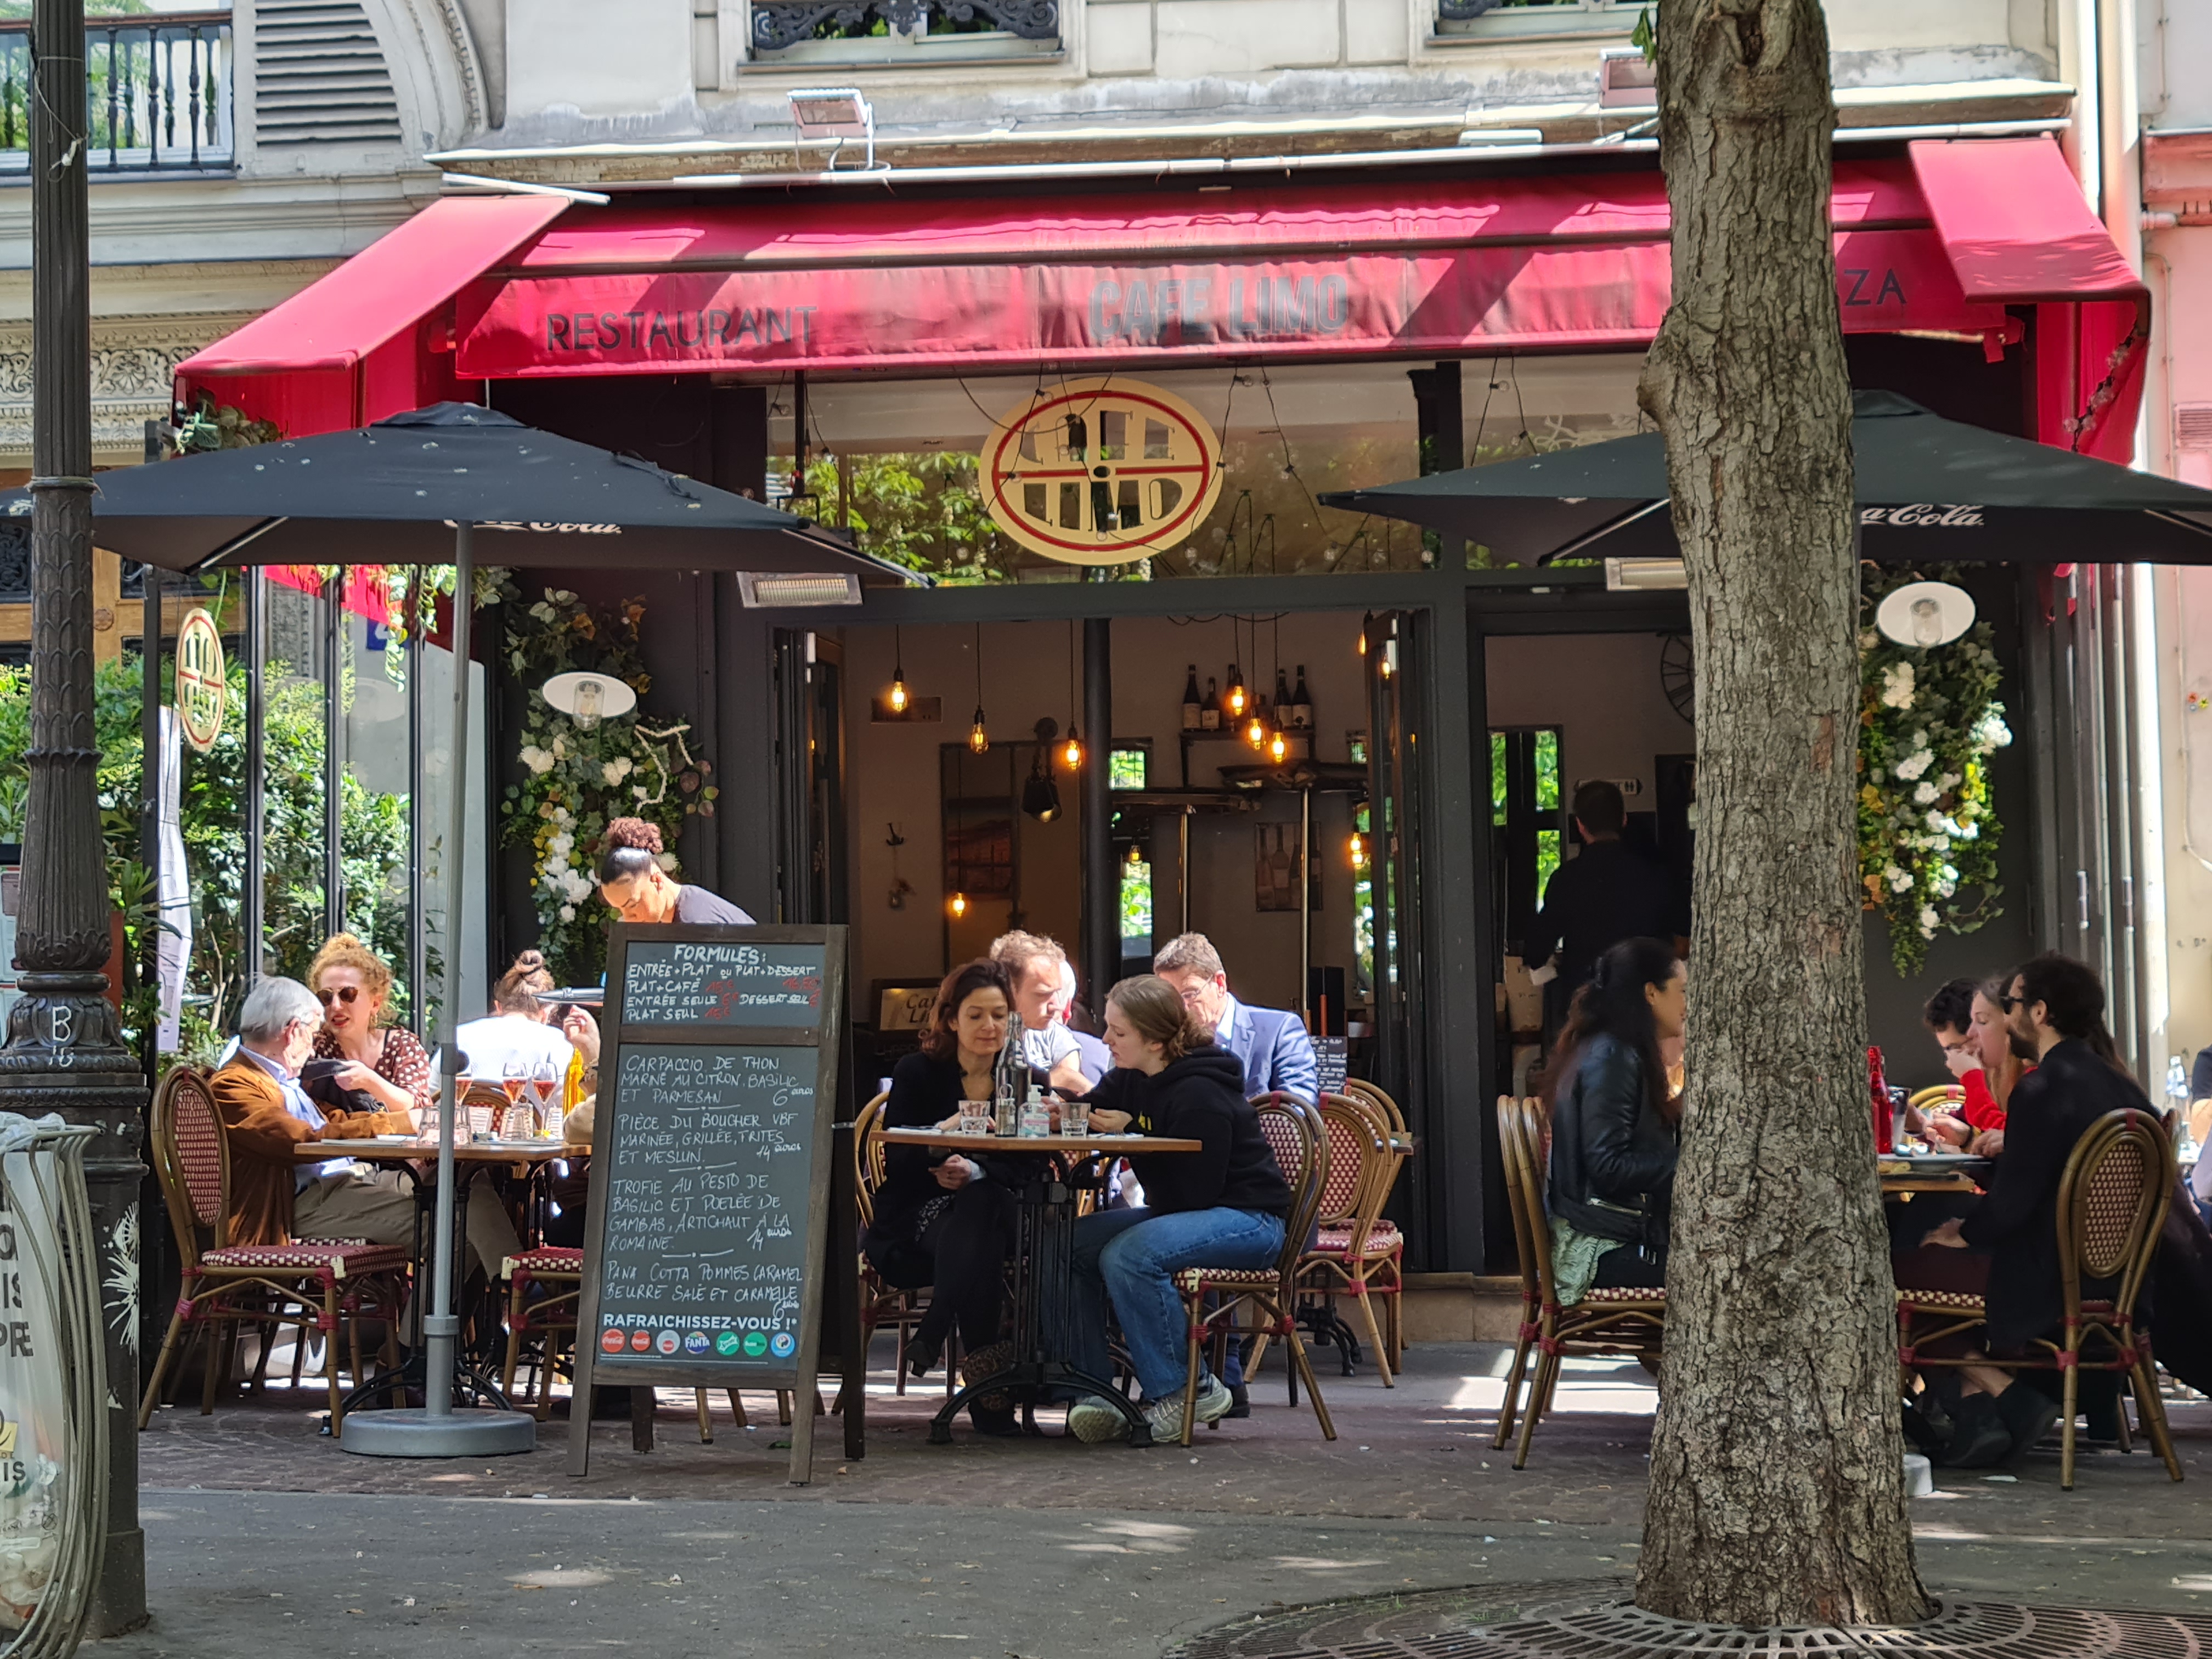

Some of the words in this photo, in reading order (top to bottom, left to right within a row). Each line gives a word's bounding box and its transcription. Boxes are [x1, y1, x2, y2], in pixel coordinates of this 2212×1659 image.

[1844, 269, 1907, 306] ZA
[1229, 274, 1348, 335] LIMO
[547, 305, 817, 351] RESTAURANT
[1861, 504, 1985, 527] a-Cola
[627, 994, 676, 1007] ENTRÉE
[682, 995, 718, 1006] SEULE
[740, 994, 787, 1005] DESSERT
[52, 1006, 72, 1042] B
[627, 1009, 659, 1021] PLAT
[663, 1008, 699, 1021] SEUL
[713, 1056, 736, 1071] DE
[743, 1057, 780, 1070] THON
[672, 1074, 690, 1087] AU
[622, 1088, 641, 1103] ET
[653, 1088, 722, 1104] PARMESAN
[773, 1088, 788, 1106] 6
[618, 1112, 659, 1131] PIÈCE
[669, 1115, 692, 1129] DU
[701, 1112, 762, 1128] BOUCHER
[772, 1113, 798, 1126] VBF
[619, 1150, 640, 1165] ET
[671, 1177, 692, 1193] AU
[699, 1172, 740, 1189] PESTO
[747, 1174, 769, 1189] DE
[670, 1196, 695, 1212] ET
[758, 1193, 782, 1209] DE
[674, 1213, 751, 1233] ARTICHAUT
[773, 1214, 790, 1228] LA
[747, 1228, 764, 1251] 14
[650, 1262, 690, 1282] COTTA
[698, 1263, 750, 1282] POMMES
[753, 1263, 803, 1282] CARAMEL
[672, 1283, 707, 1302] SALÉ
[710, 1286, 729, 1302] ET
[685, 1335, 711, 1350] FANTA
